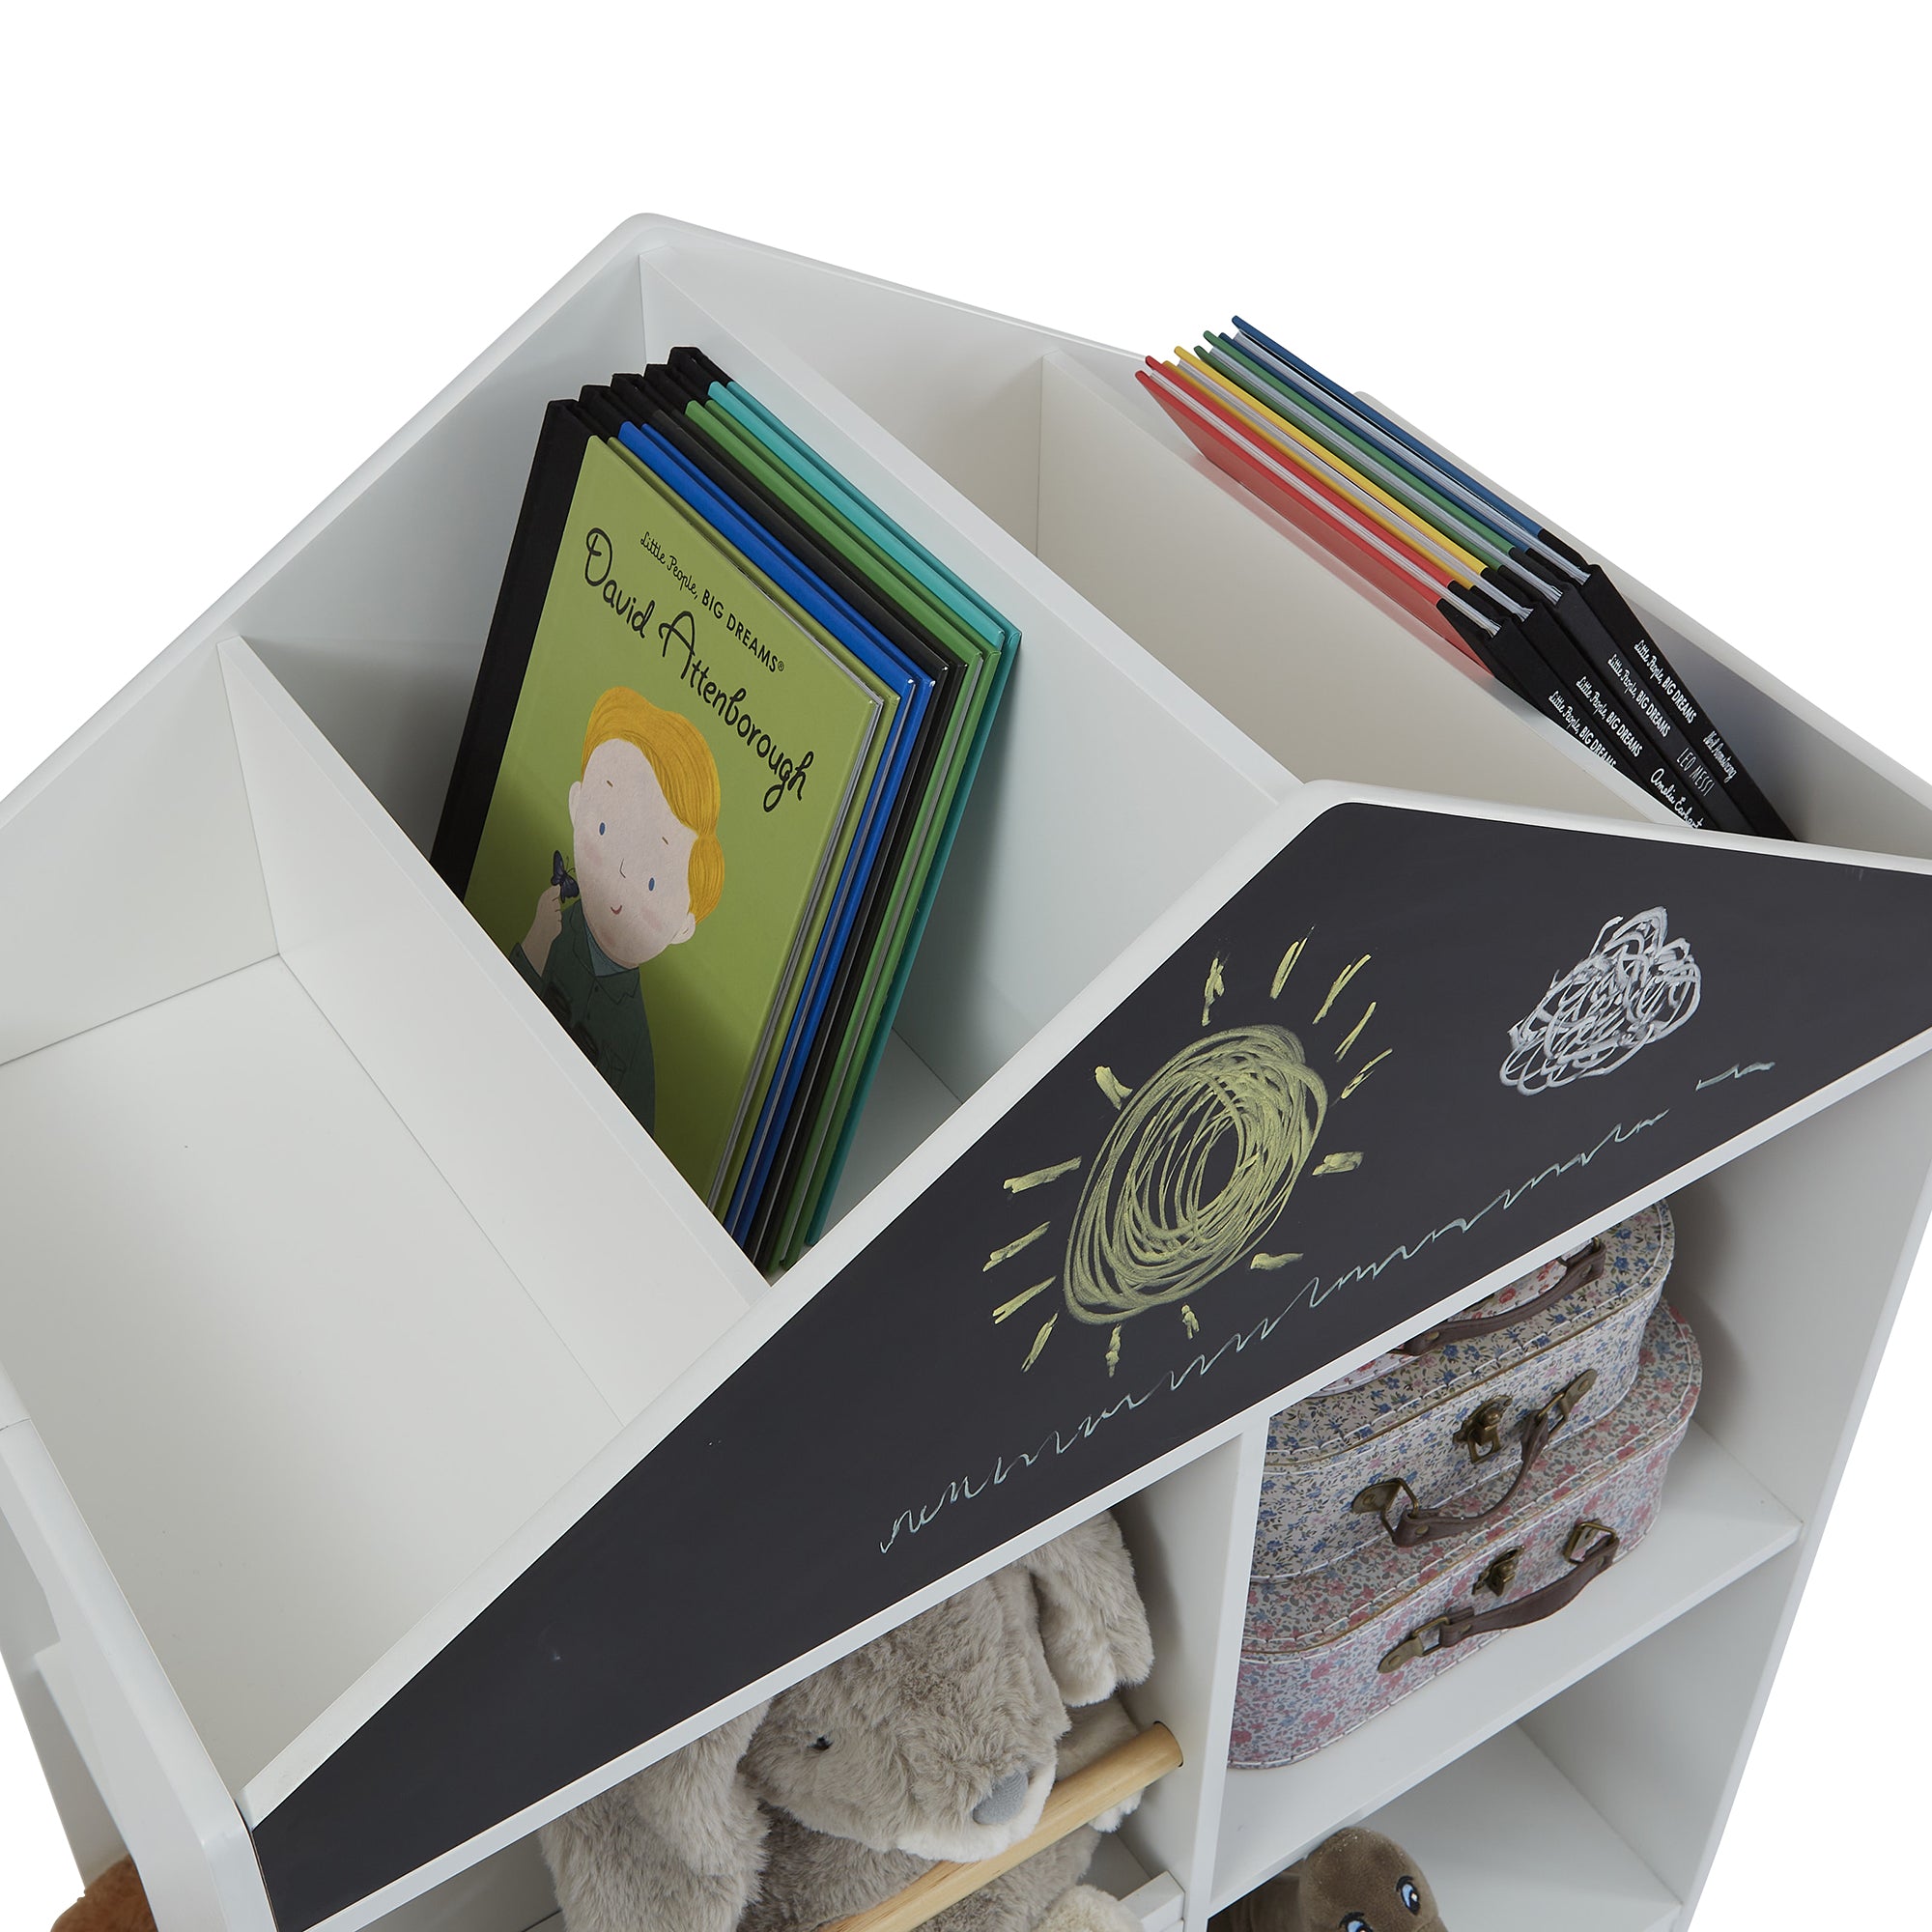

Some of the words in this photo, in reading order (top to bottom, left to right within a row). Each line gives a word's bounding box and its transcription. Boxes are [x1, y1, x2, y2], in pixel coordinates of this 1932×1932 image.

[640, 531, 666, 564] Little
[667, 555, 698, 600] People,
[701, 588, 724, 619] BIG
[584, 527, 655, 639] David
[658, 611, 814, 812] Attenborough
[1607, 654, 1624, 677] Little
[1635, 690, 1650, 710] BIG
[1645, 702, 1671, 737] DREAMS
[1634, 639, 1650, 663] Little
[1662, 676, 1677, 696] BIG
[1671, 690, 1697, 724] DREAMS
[1548, 690, 1566, 714] Little
[1578, 725, 1595, 745] BIG
[1576, 676, 1593, 698] Little
[1605, 711, 1621, 730] BIG
[1615, 724, 1643, 757] DREAMS
[1676, 747, 1697, 772] LEO
[1689, 764, 1716, 797] MESSI
